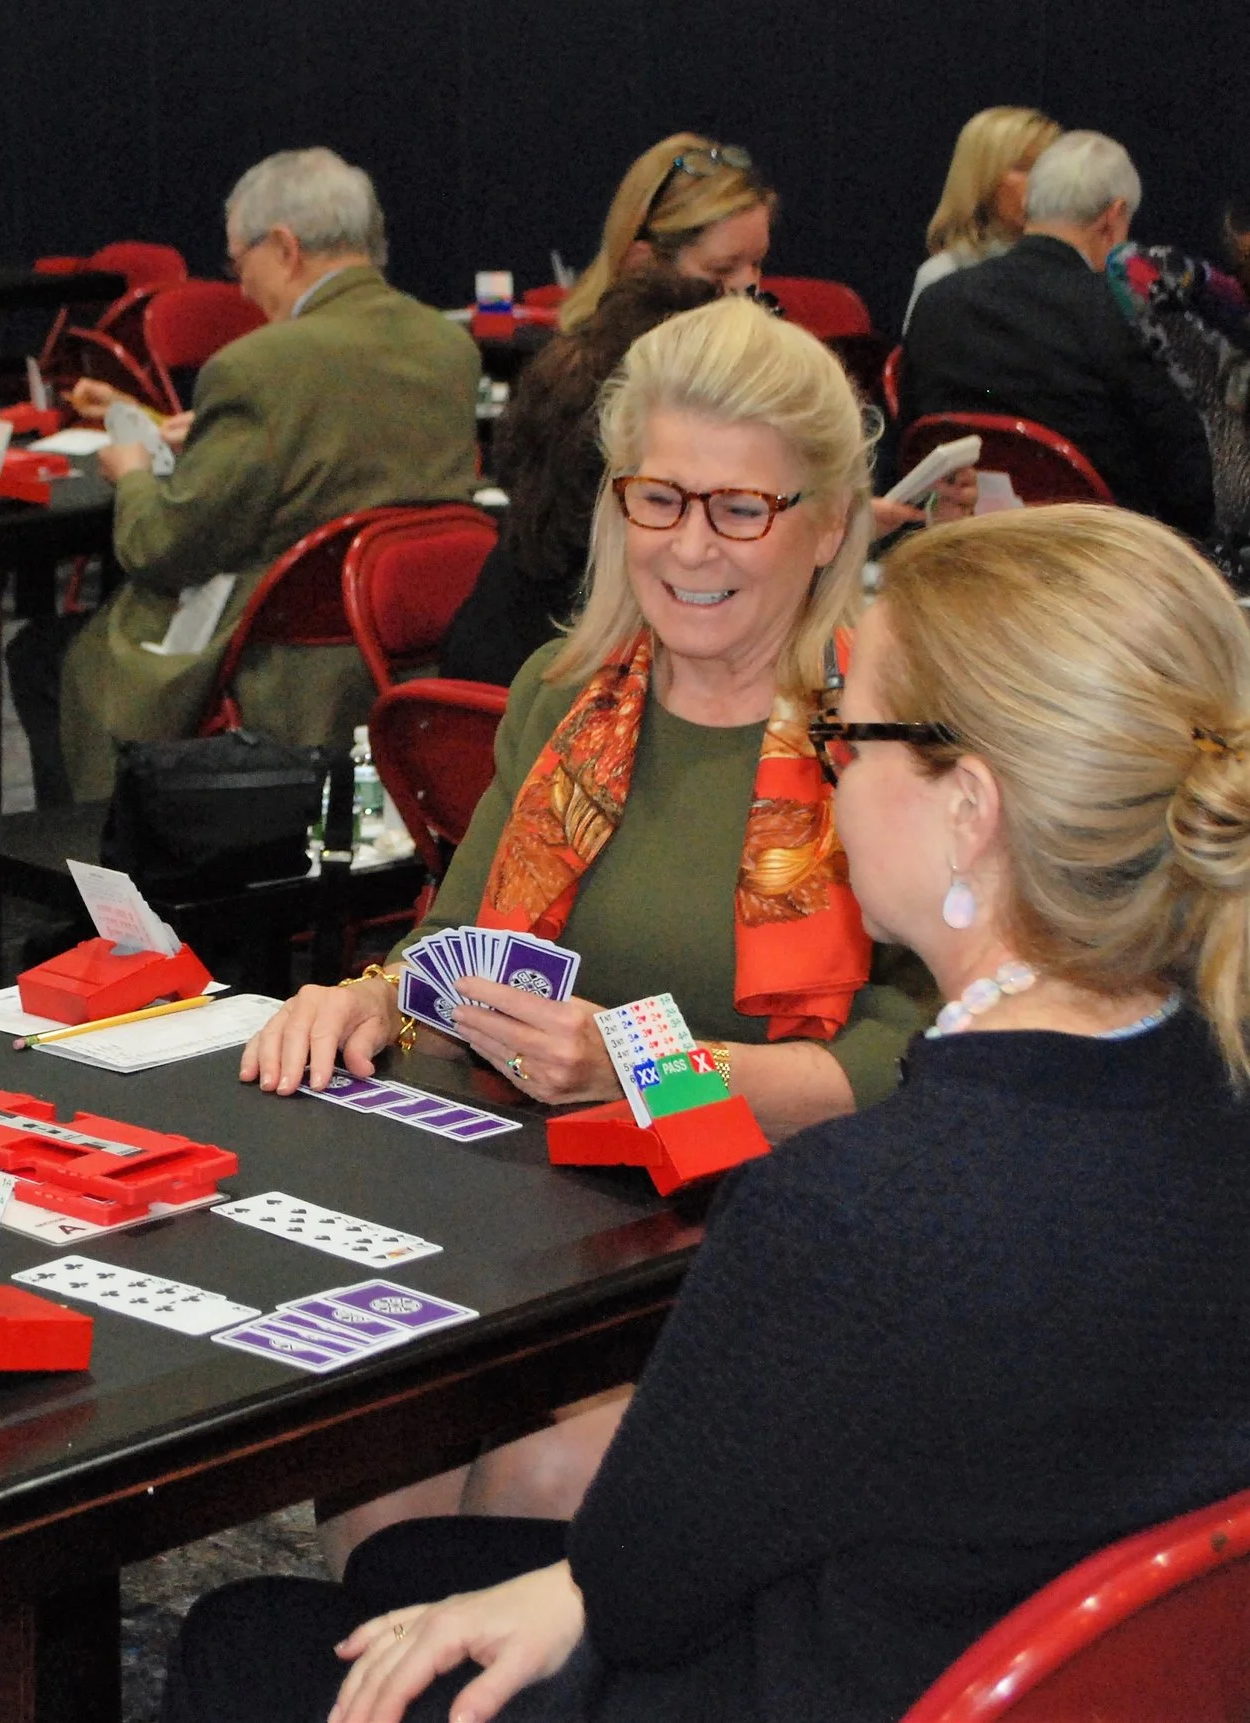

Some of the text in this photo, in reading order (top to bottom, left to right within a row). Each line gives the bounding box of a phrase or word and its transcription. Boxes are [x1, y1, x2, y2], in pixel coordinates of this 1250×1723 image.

[637, 1053, 712, 1085] XX PASS X
[58, 1225, 86, 1235] A
